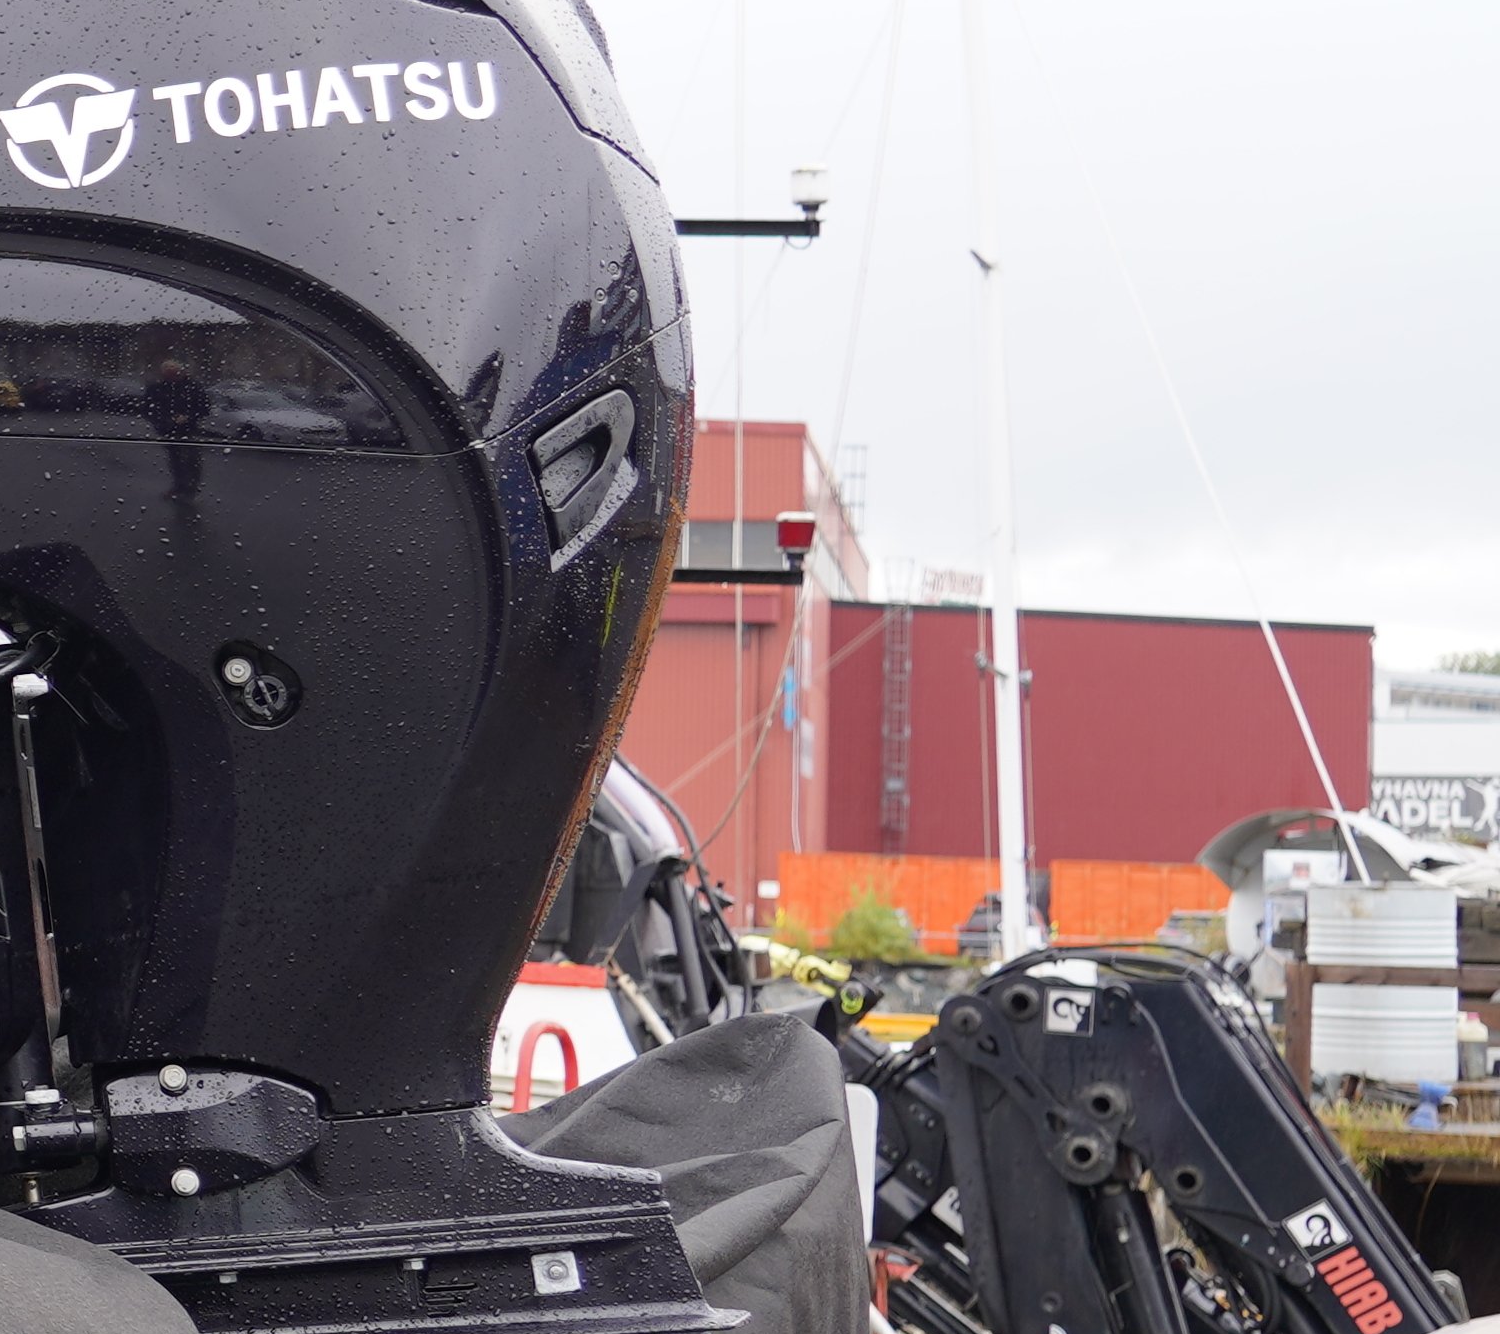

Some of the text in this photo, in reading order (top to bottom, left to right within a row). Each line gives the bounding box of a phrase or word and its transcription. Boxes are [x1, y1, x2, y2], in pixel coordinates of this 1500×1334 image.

[152, 61, 496, 144] TOHATSU
[1371, 777, 1467, 801] YHAVNA
[1369, 797, 1474, 828] ADEL
